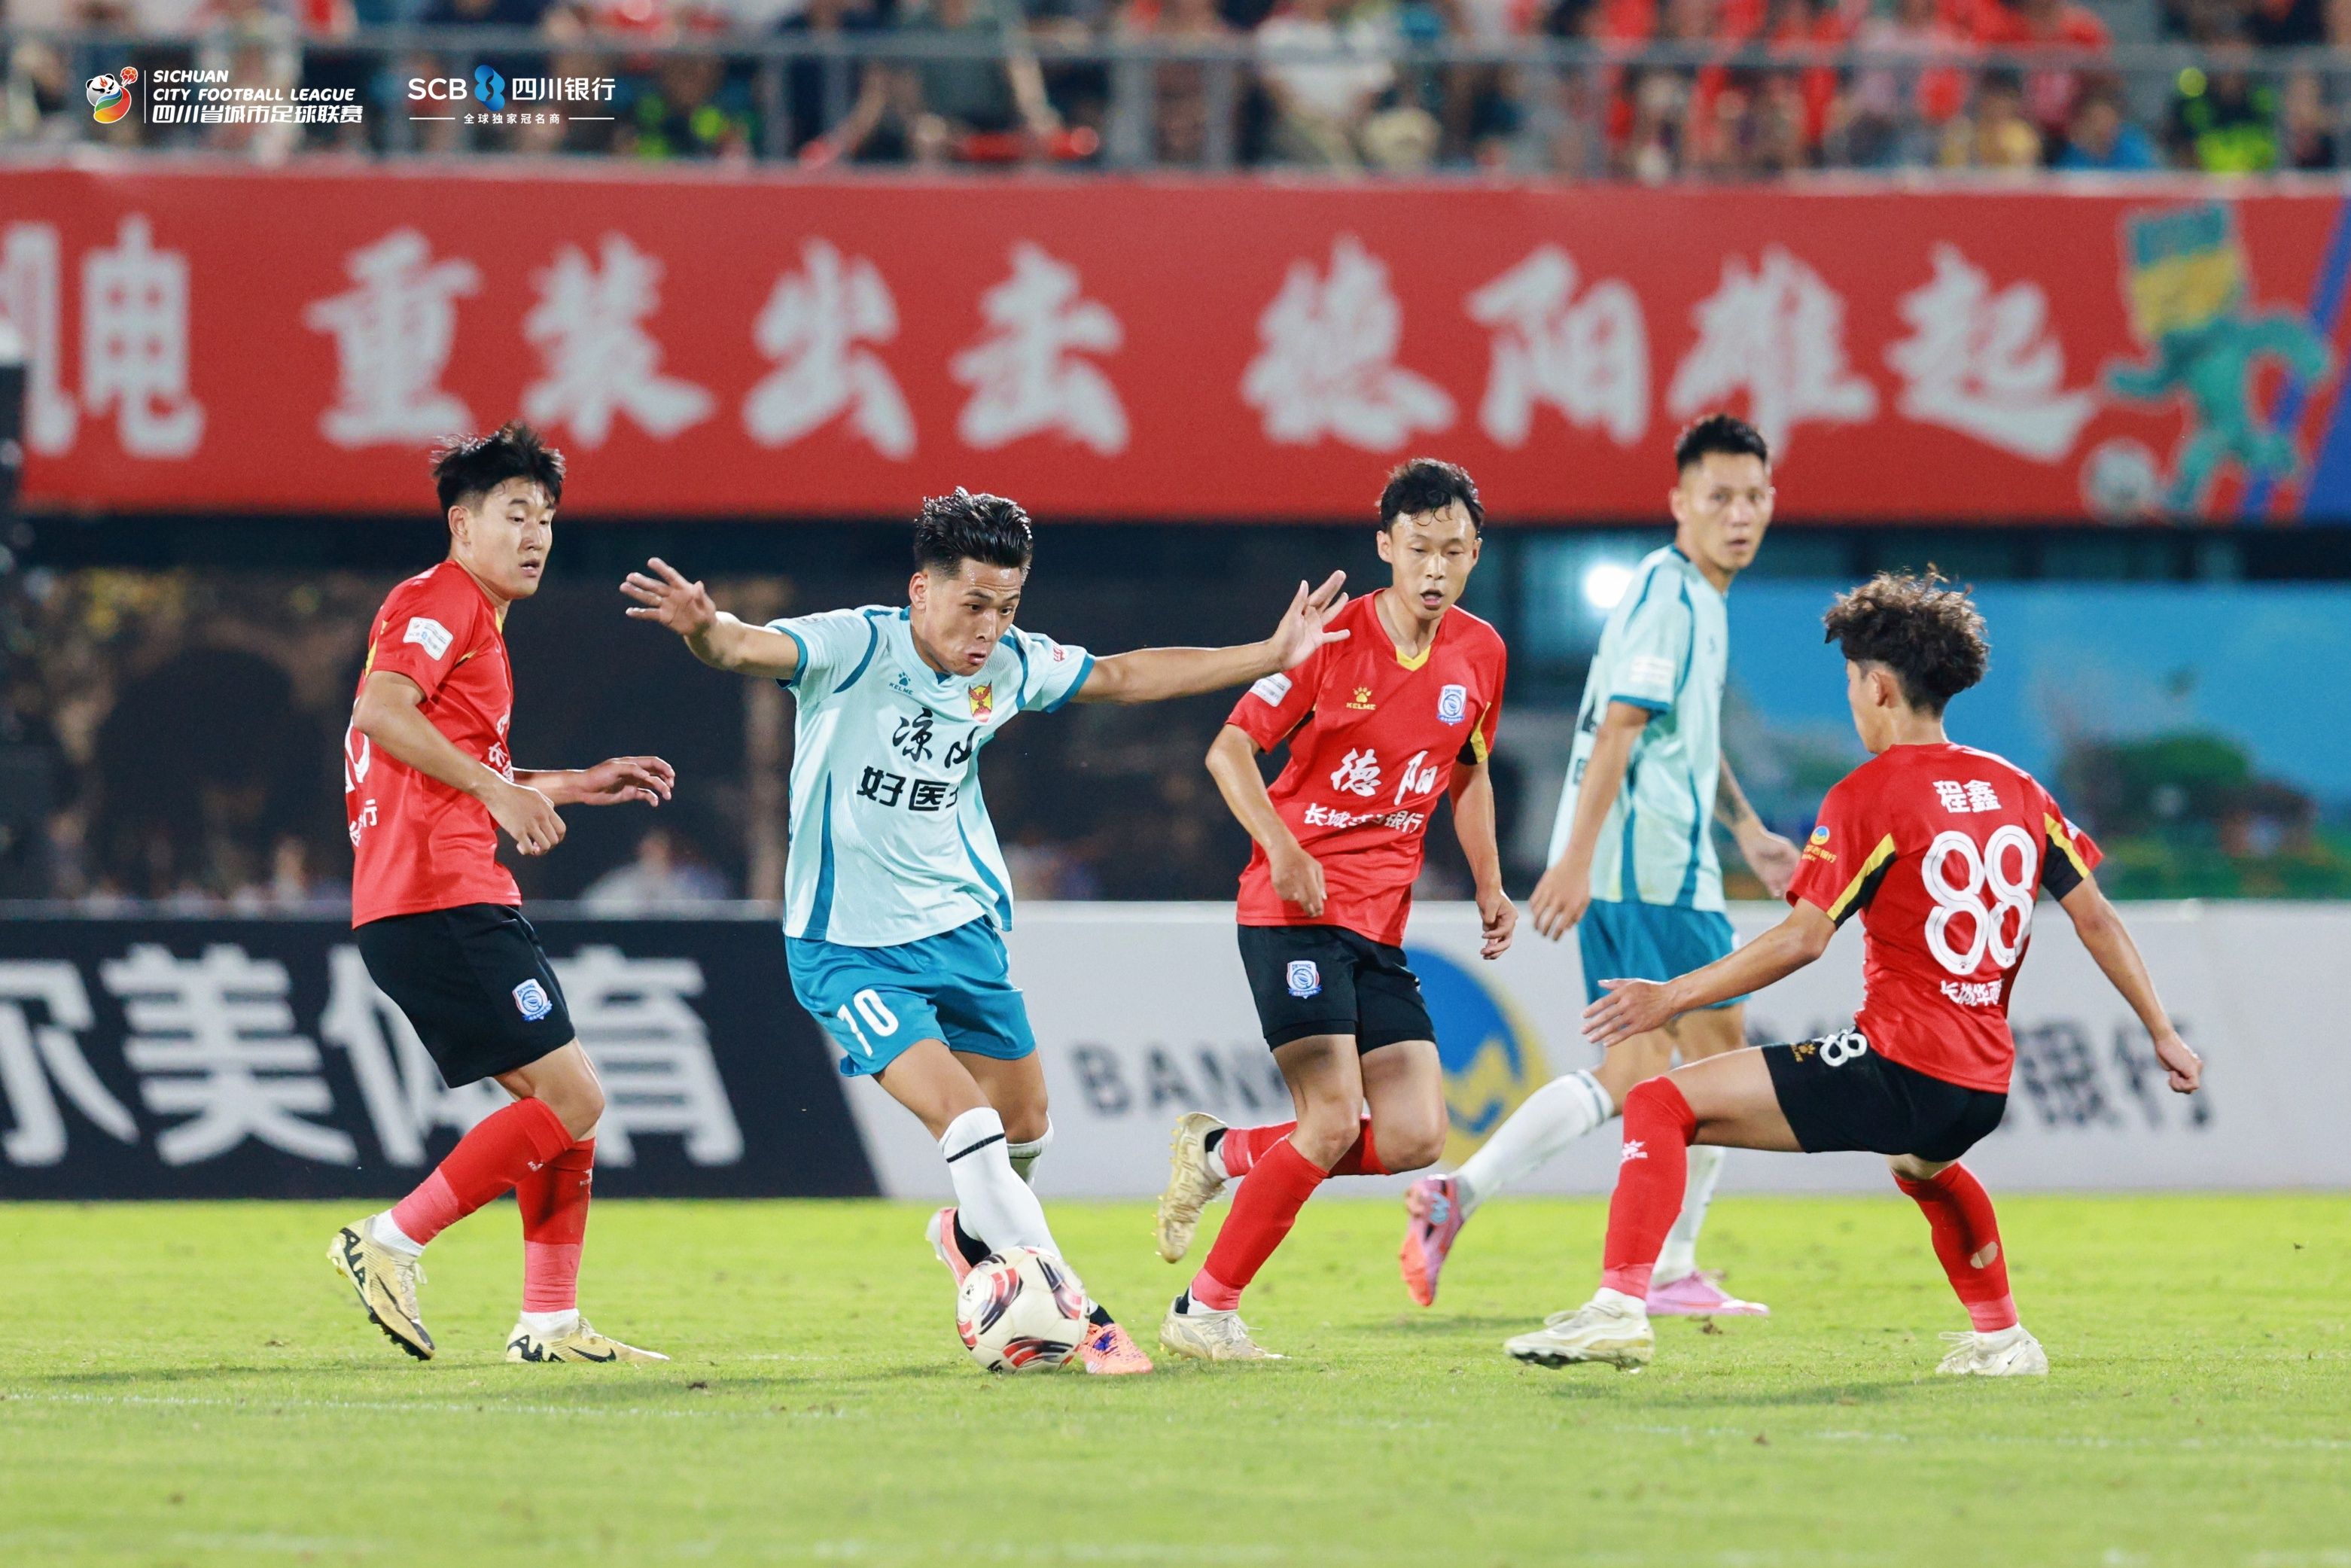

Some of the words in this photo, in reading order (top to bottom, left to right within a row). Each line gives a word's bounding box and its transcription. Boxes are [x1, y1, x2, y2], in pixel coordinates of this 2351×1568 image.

[1242, 235, 2097, 462] 德阳雄起
[889, 682, 913, 696] KELME
[1346, 702, 1377, 711] KELME
[1329, 747, 1439, 806] 德阳
[1932, 779, 2002, 813] 程鑫
[1304, 802, 1425, 834] 长城银行
[1921, 824, 2039, 976] 88
[837, 988, 899, 1058] 10
[1070, 1043, 1289, 1116] BAN
